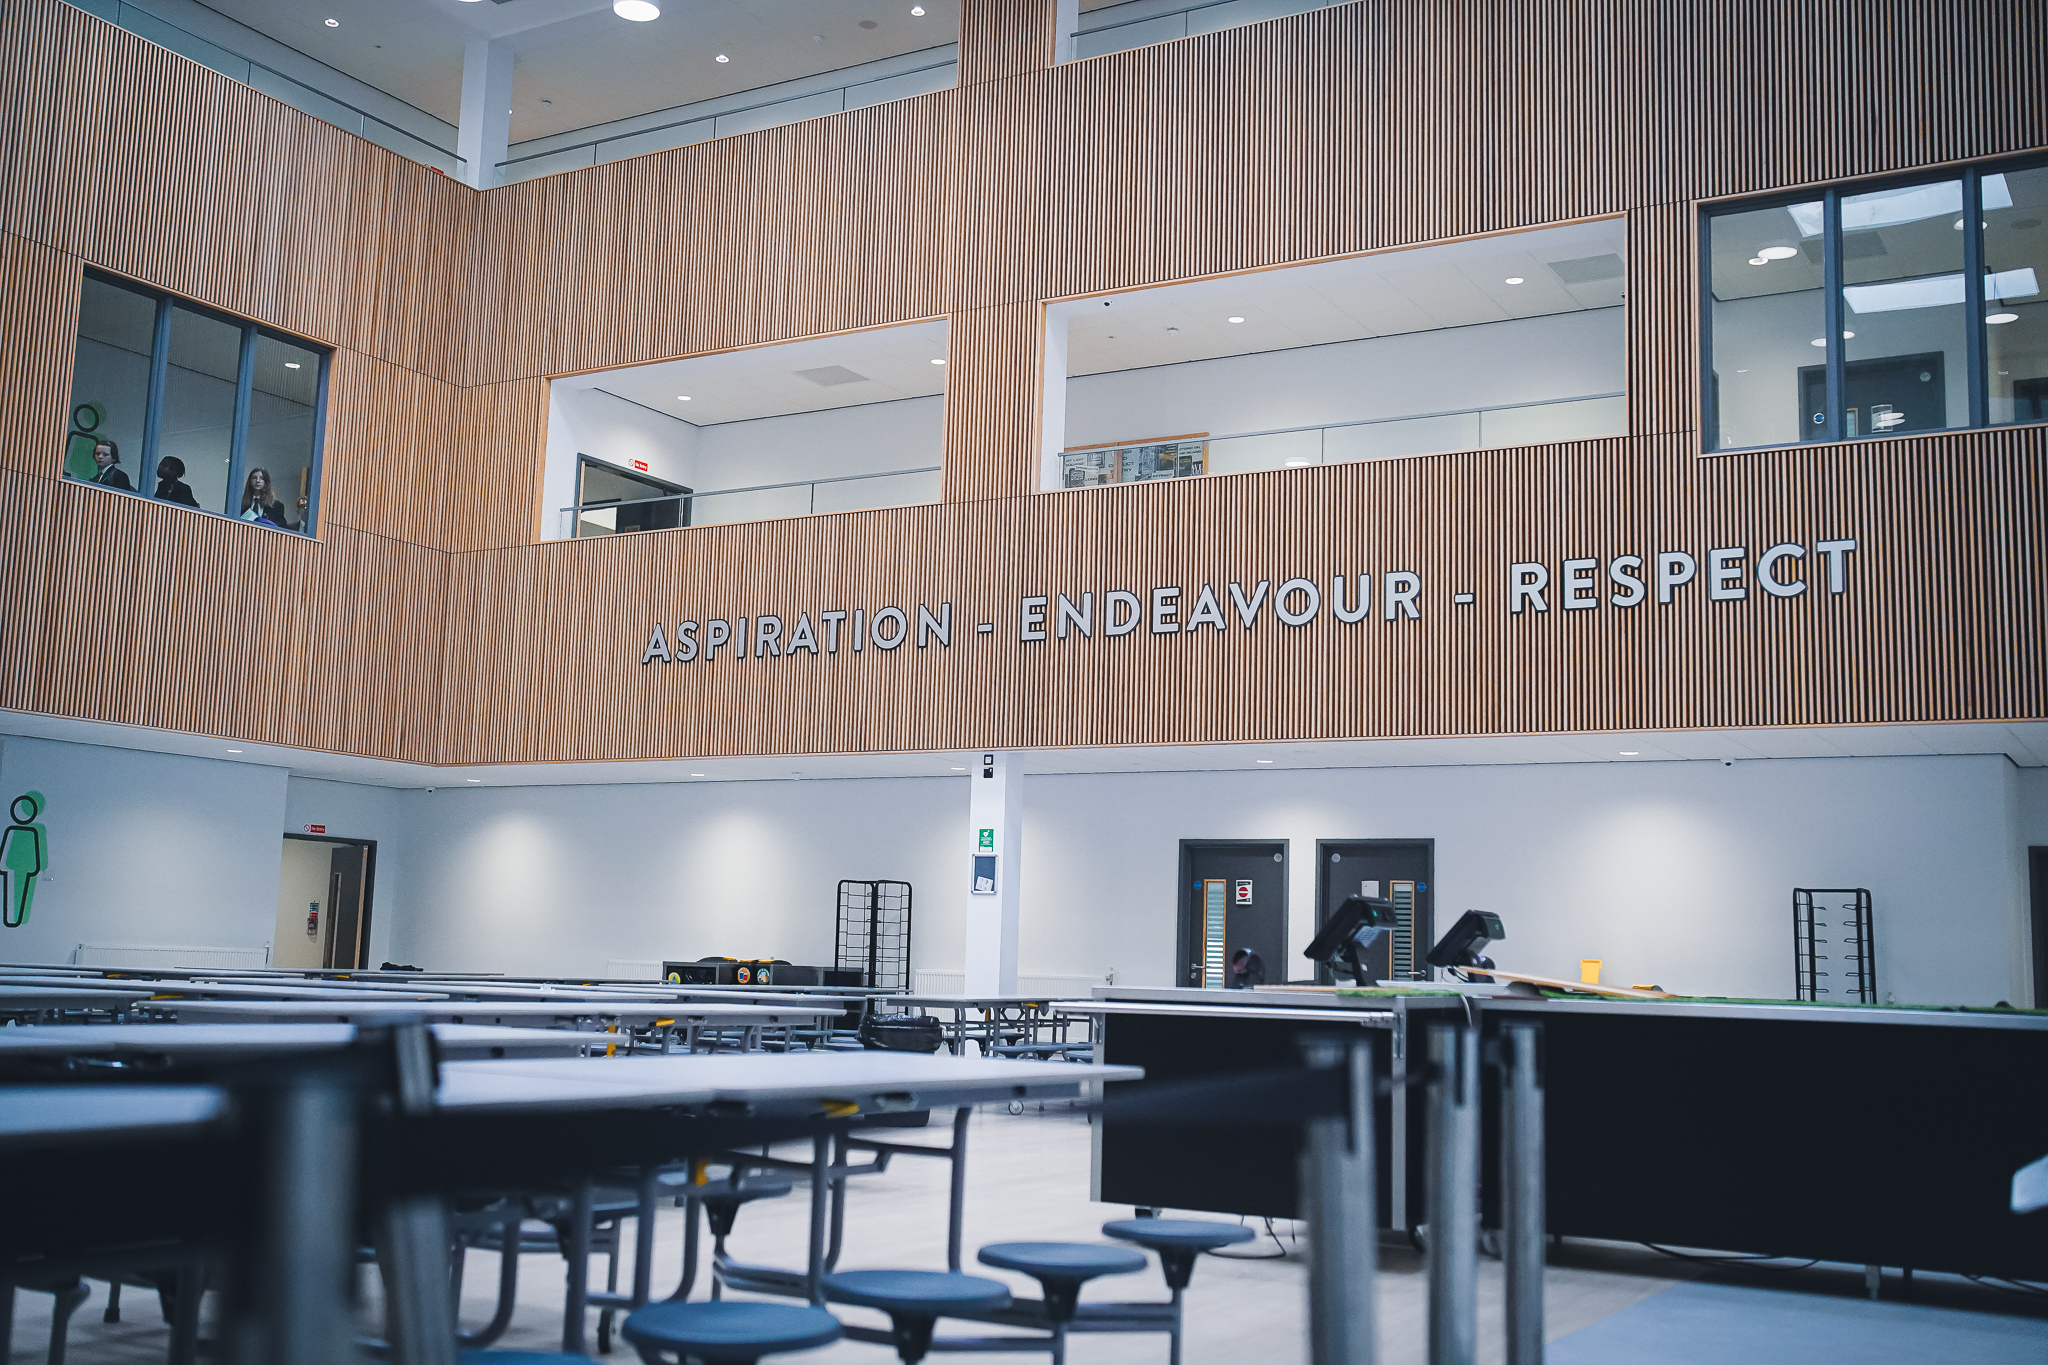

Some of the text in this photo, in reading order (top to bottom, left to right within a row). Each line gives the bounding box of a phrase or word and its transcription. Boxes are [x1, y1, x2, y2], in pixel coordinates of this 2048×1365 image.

[642, 602, 951, 664] ASPIRATION
[1021, 571, 1422, 642] ENDEAVOUR
[1511, 539, 1857, 613] RESPECT
